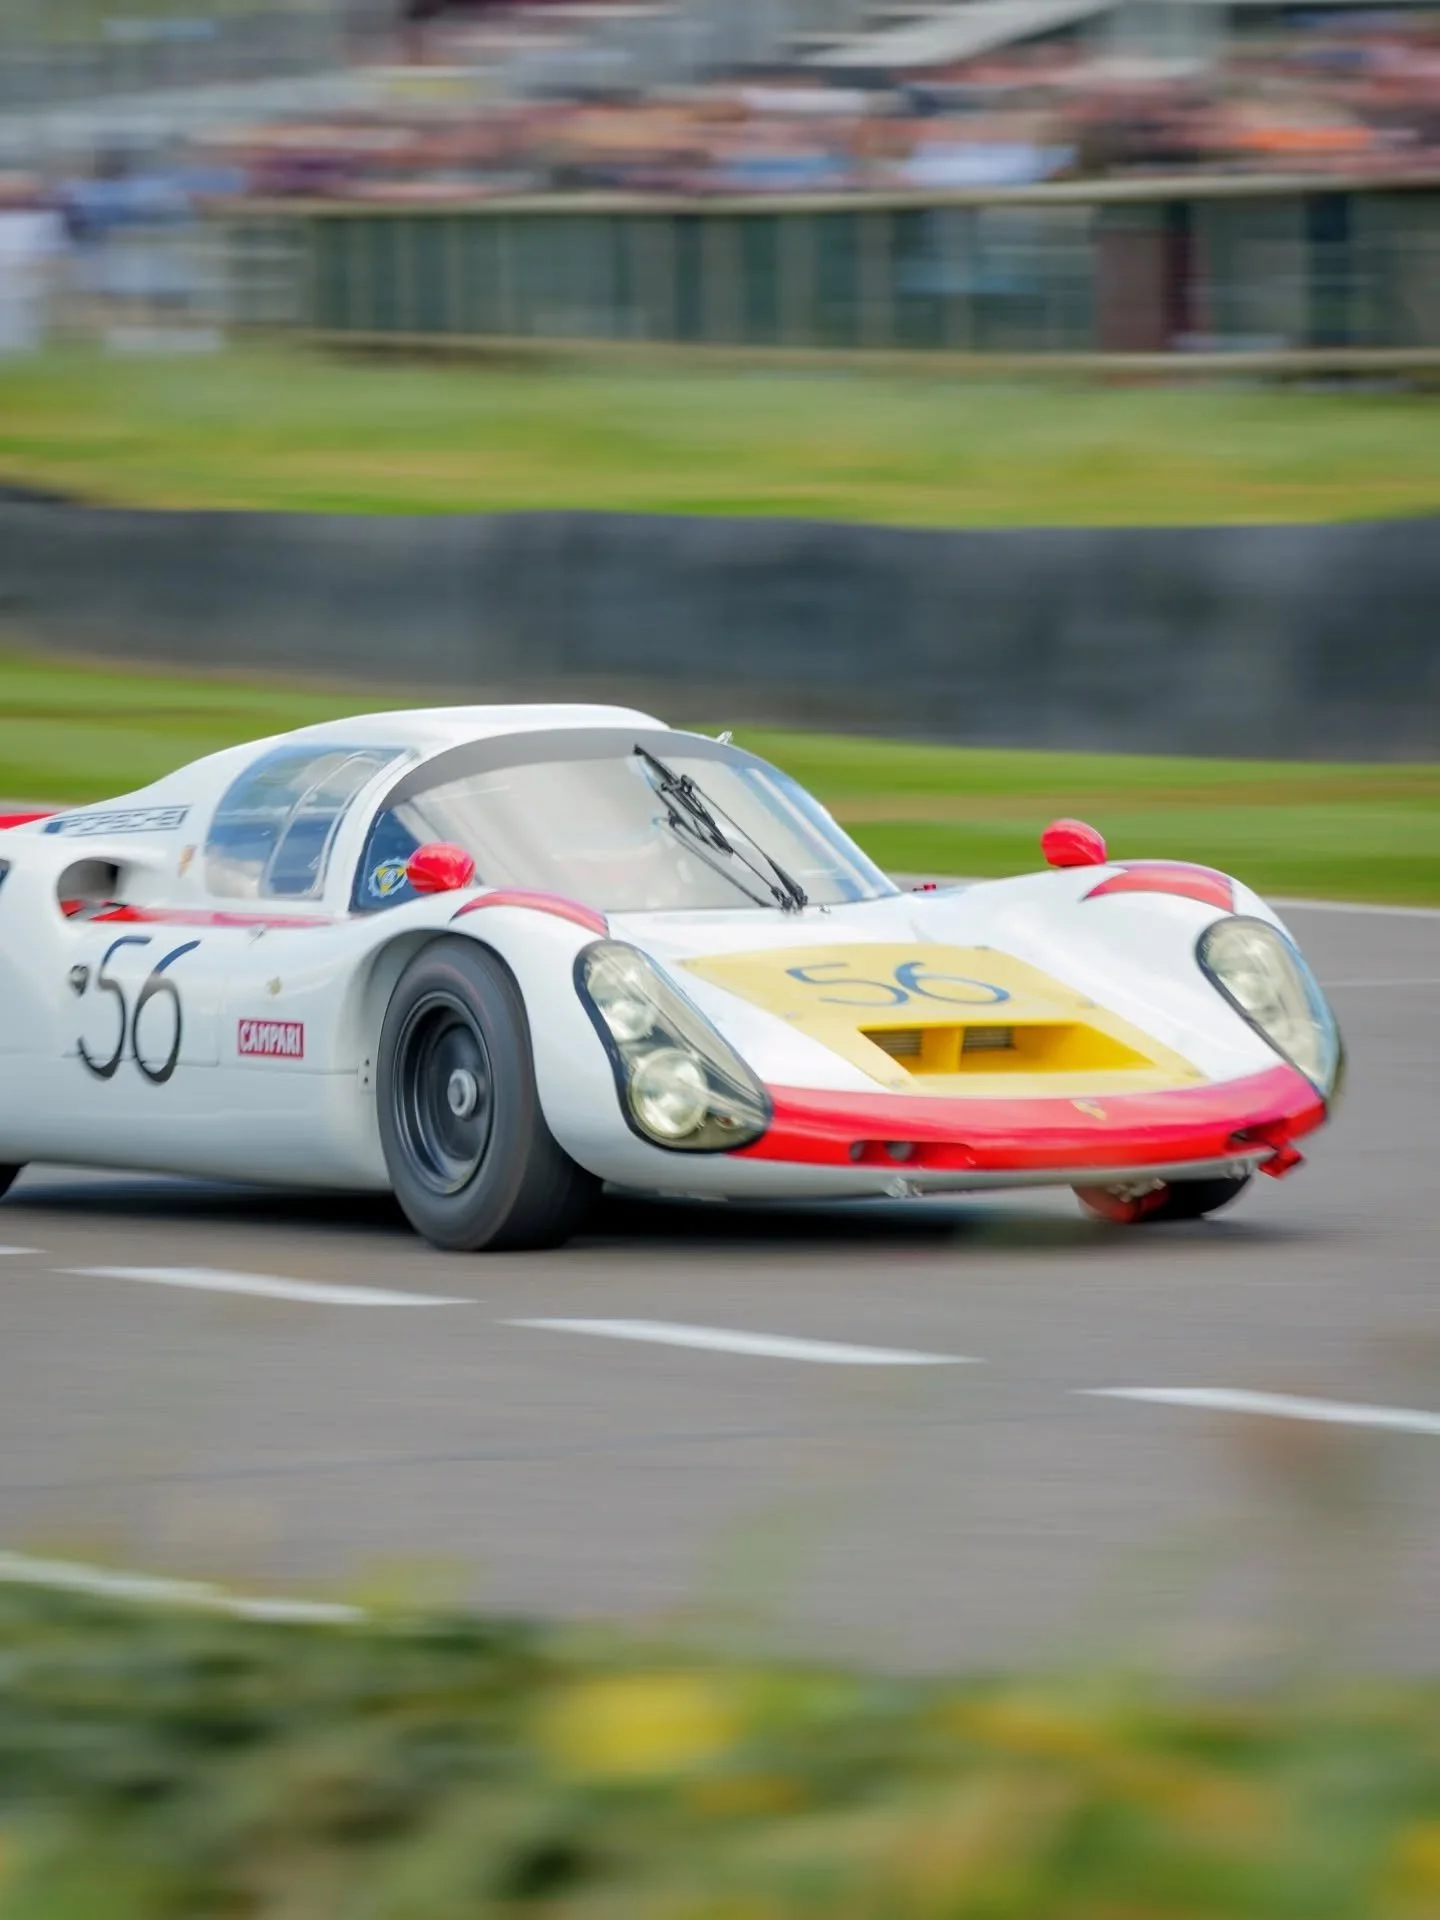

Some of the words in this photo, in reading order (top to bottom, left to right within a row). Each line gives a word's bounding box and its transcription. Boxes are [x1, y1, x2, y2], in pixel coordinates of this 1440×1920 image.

[785, 961, 1010, 1005] 56
[77, 935, 201, 1086] 56
[240, 1021, 301, 1055] CAMPARI
